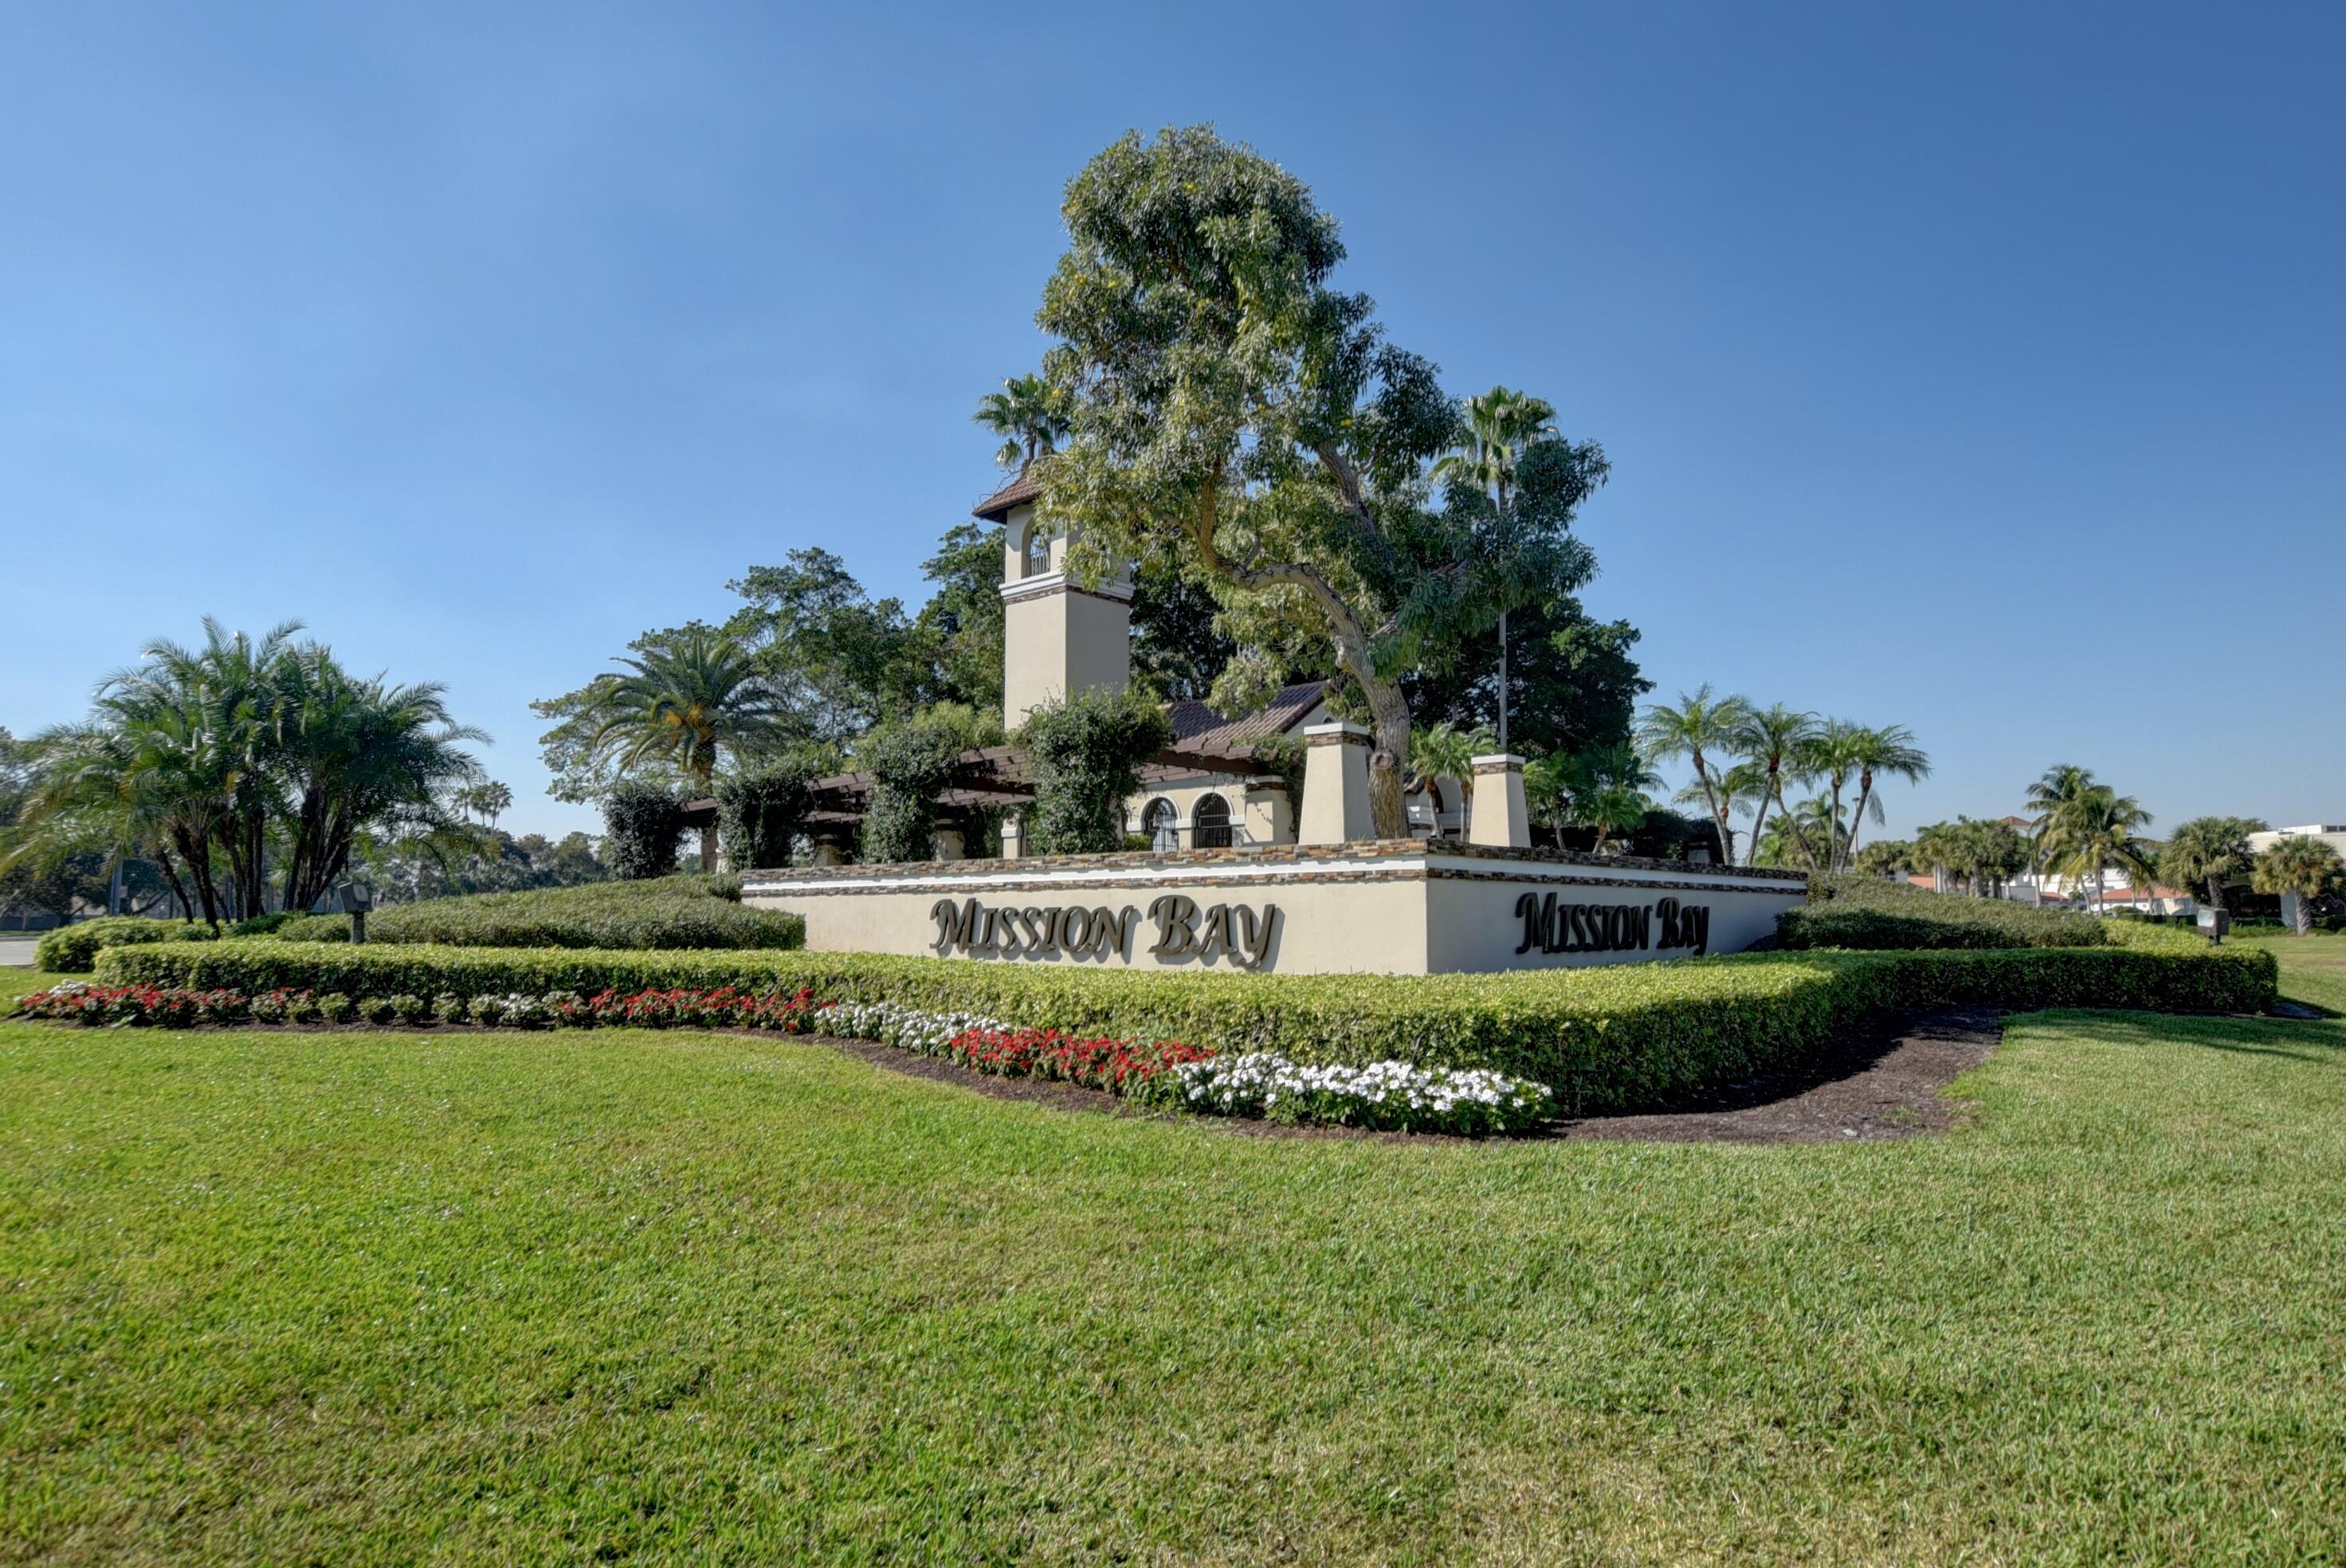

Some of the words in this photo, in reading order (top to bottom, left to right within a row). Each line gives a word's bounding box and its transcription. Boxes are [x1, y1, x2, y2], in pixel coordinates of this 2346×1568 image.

[929, 897, 1136, 955] MISSION
[1147, 895, 1275, 968] BAY
[1516, 892, 1651, 954] MISSION
[1656, 896, 1708, 956] BAY
